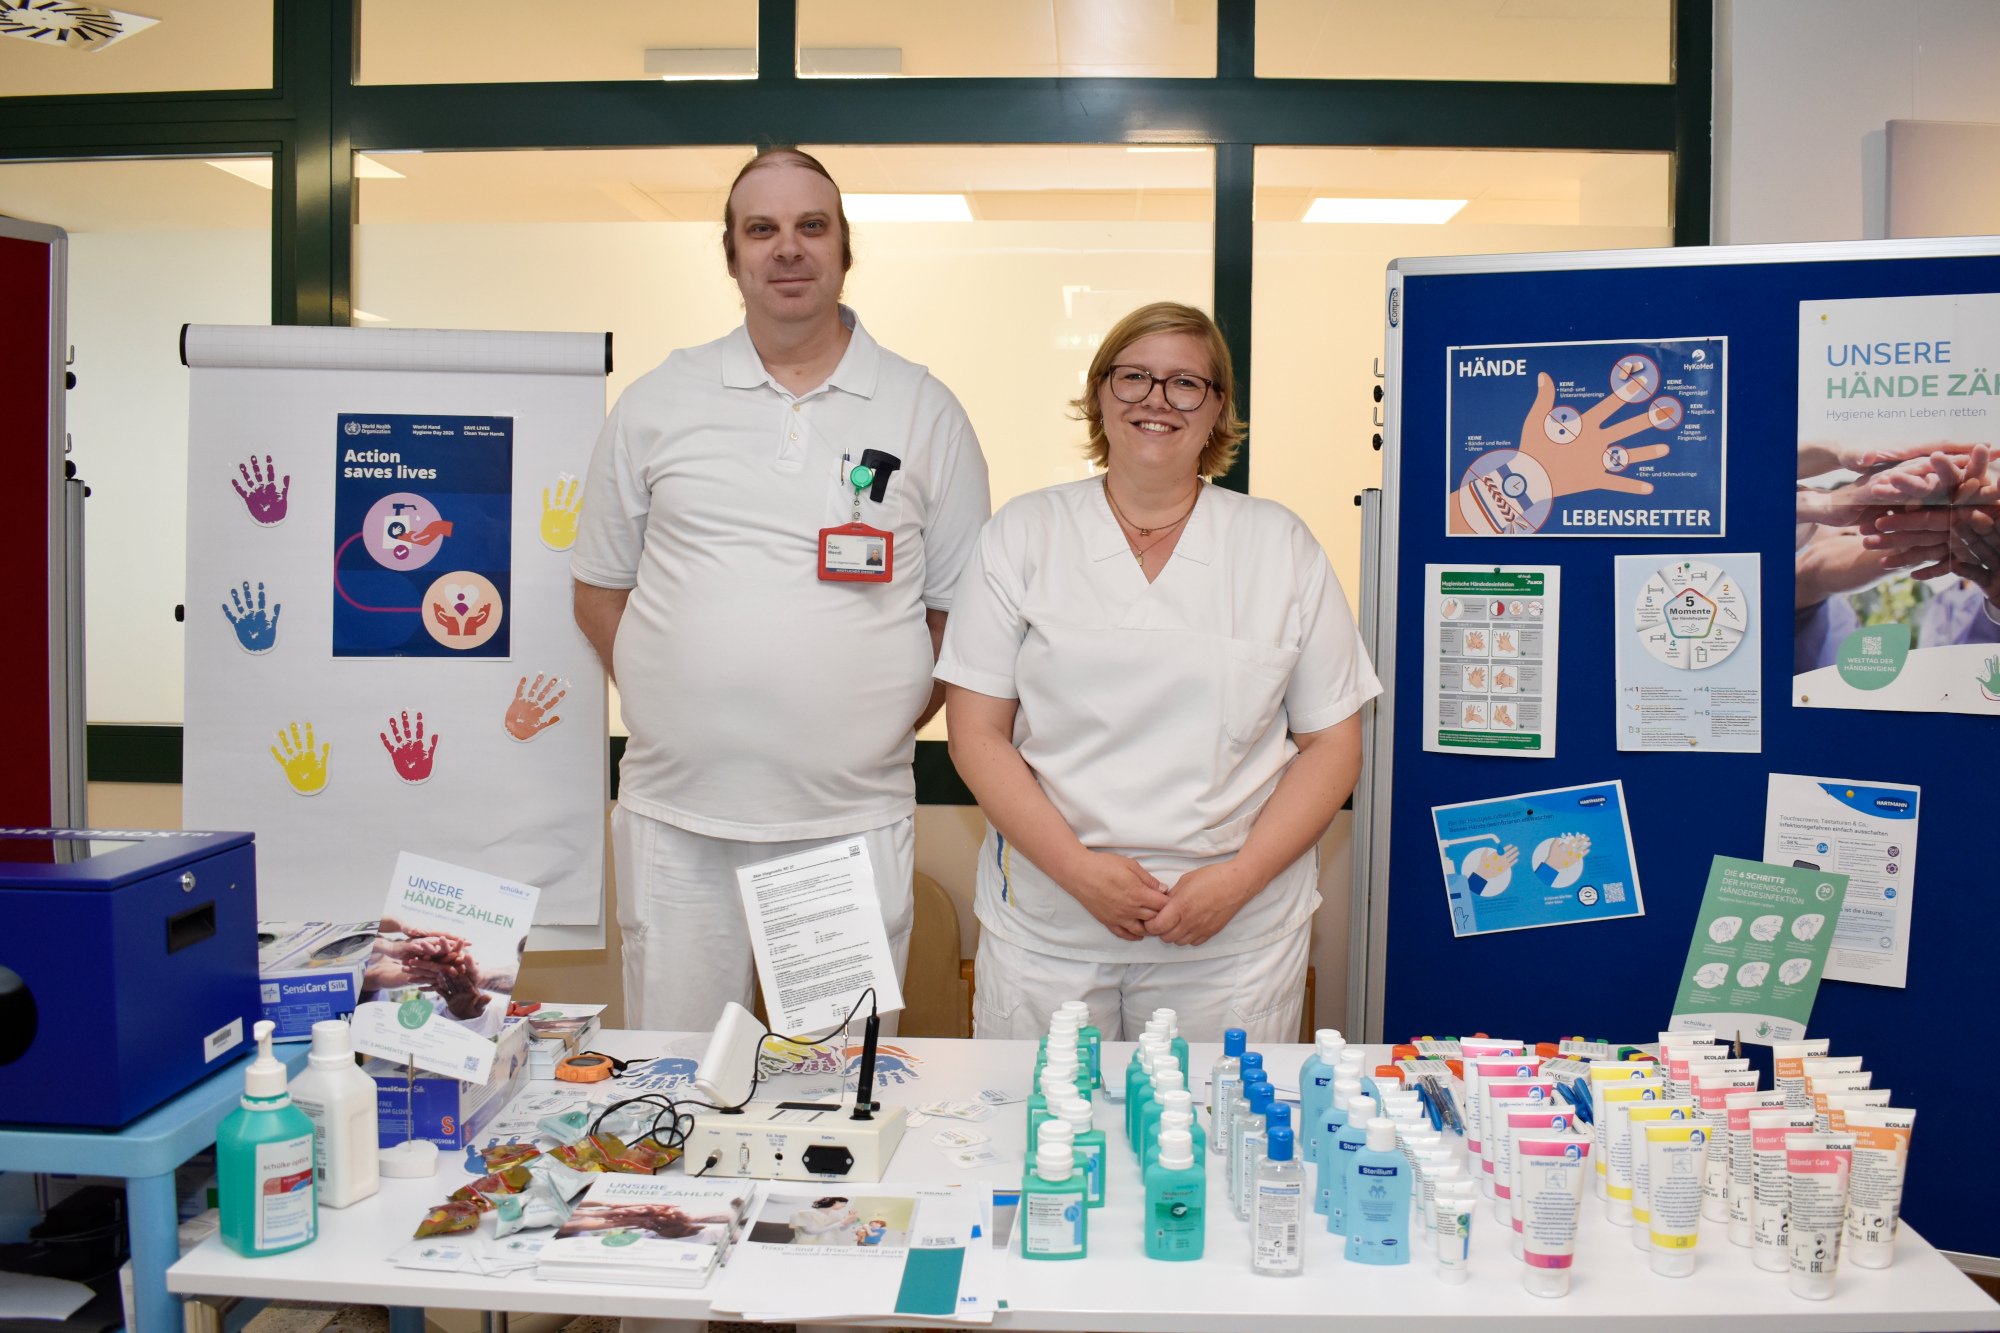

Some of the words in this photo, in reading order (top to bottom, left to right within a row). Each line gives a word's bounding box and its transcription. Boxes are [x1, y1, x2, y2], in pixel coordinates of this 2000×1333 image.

[1827, 341, 1951, 367] UNSERE
[1459, 356, 1527, 378] HÄNDE
[1684, 362, 1714, 370] HyKoMed
[1826, 371, 1939, 399] HÄNDE
[1826, 409, 1874, 422] Hygiene
[1877, 408, 1906, 419] kann
[1910, 408, 1946, 418] Leben
[1949, 407, 1986, 417] retten
[412, 429, 432, 437] Hygiene
[344, 449, 401, 463] Action
[344, 466, 393, 478] saves
[396, 464, 437, 480] lives
[1562, 509, 1711, 527] LEBENSRETTER
[1685, 596, 1695, 607] 5
[1844, 664, 1896, 673] HÄNDEHYGIENE
[1876, 800, 1908, 808] HARTMANN
[1779, 822, 1832, 832] Infektionsgefahren
[1832, 826, 1854, 834] einfach
[1854, 829, 1889, 838] ausschalten
[1724, 868, 1738, 877] DIE
[1745, 872, 1787, 885] SCHRITTE
[408, 875, 465, 900] UNSERE
[1722, 878, 1738, 887] DER
[1738, 880, 1798, 896] HYGIENISCHEN
[1719, 885, 1805, 905] HÄNDEDESINFEKTION
[403, 889, 456, 913] HÄNDE
[456, 902, 515, 928] ZÄHLEN
[282, 983, 327, 995] SensiCare
[330, 980, 346, 990] Silk
[378, 1085, 411, 1093] ensiCare
[442, 1115, 455, 1135] S
[263, 1160, 291, 1170] schülke
[1815, 1158, 1830, 1166] Care
[610, 1182, 668, 1190] UNSERE
[660, 1190, 725, 1198] ZÄHLEN
